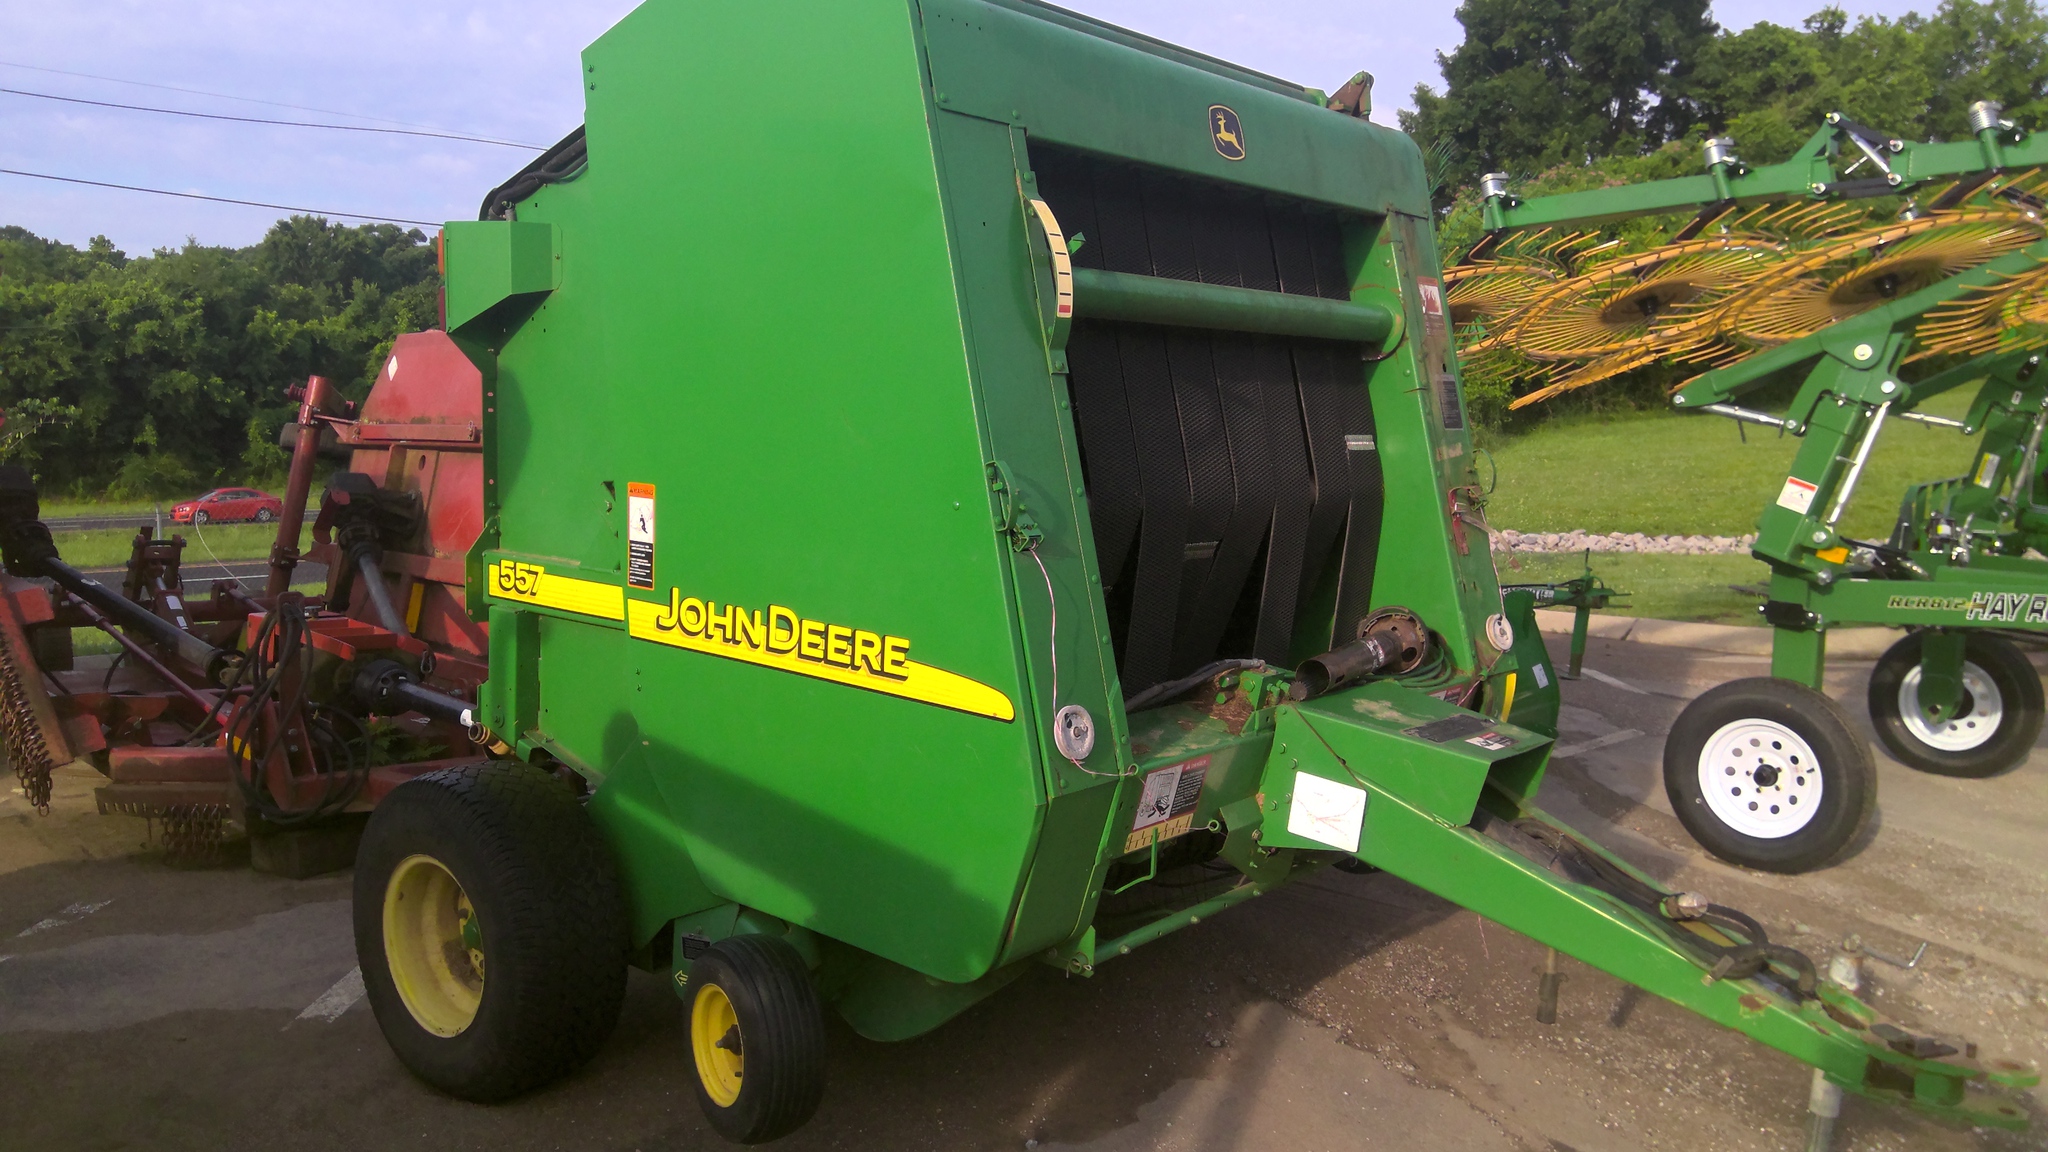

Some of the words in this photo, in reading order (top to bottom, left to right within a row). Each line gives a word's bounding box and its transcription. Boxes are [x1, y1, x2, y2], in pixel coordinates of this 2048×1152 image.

[499, 559, 545, 597] 557
[1966, 591, 2029, 622] HAY
[656, 586, 762, 649] JOHN
[765, 604, 910, 682] DEERE
